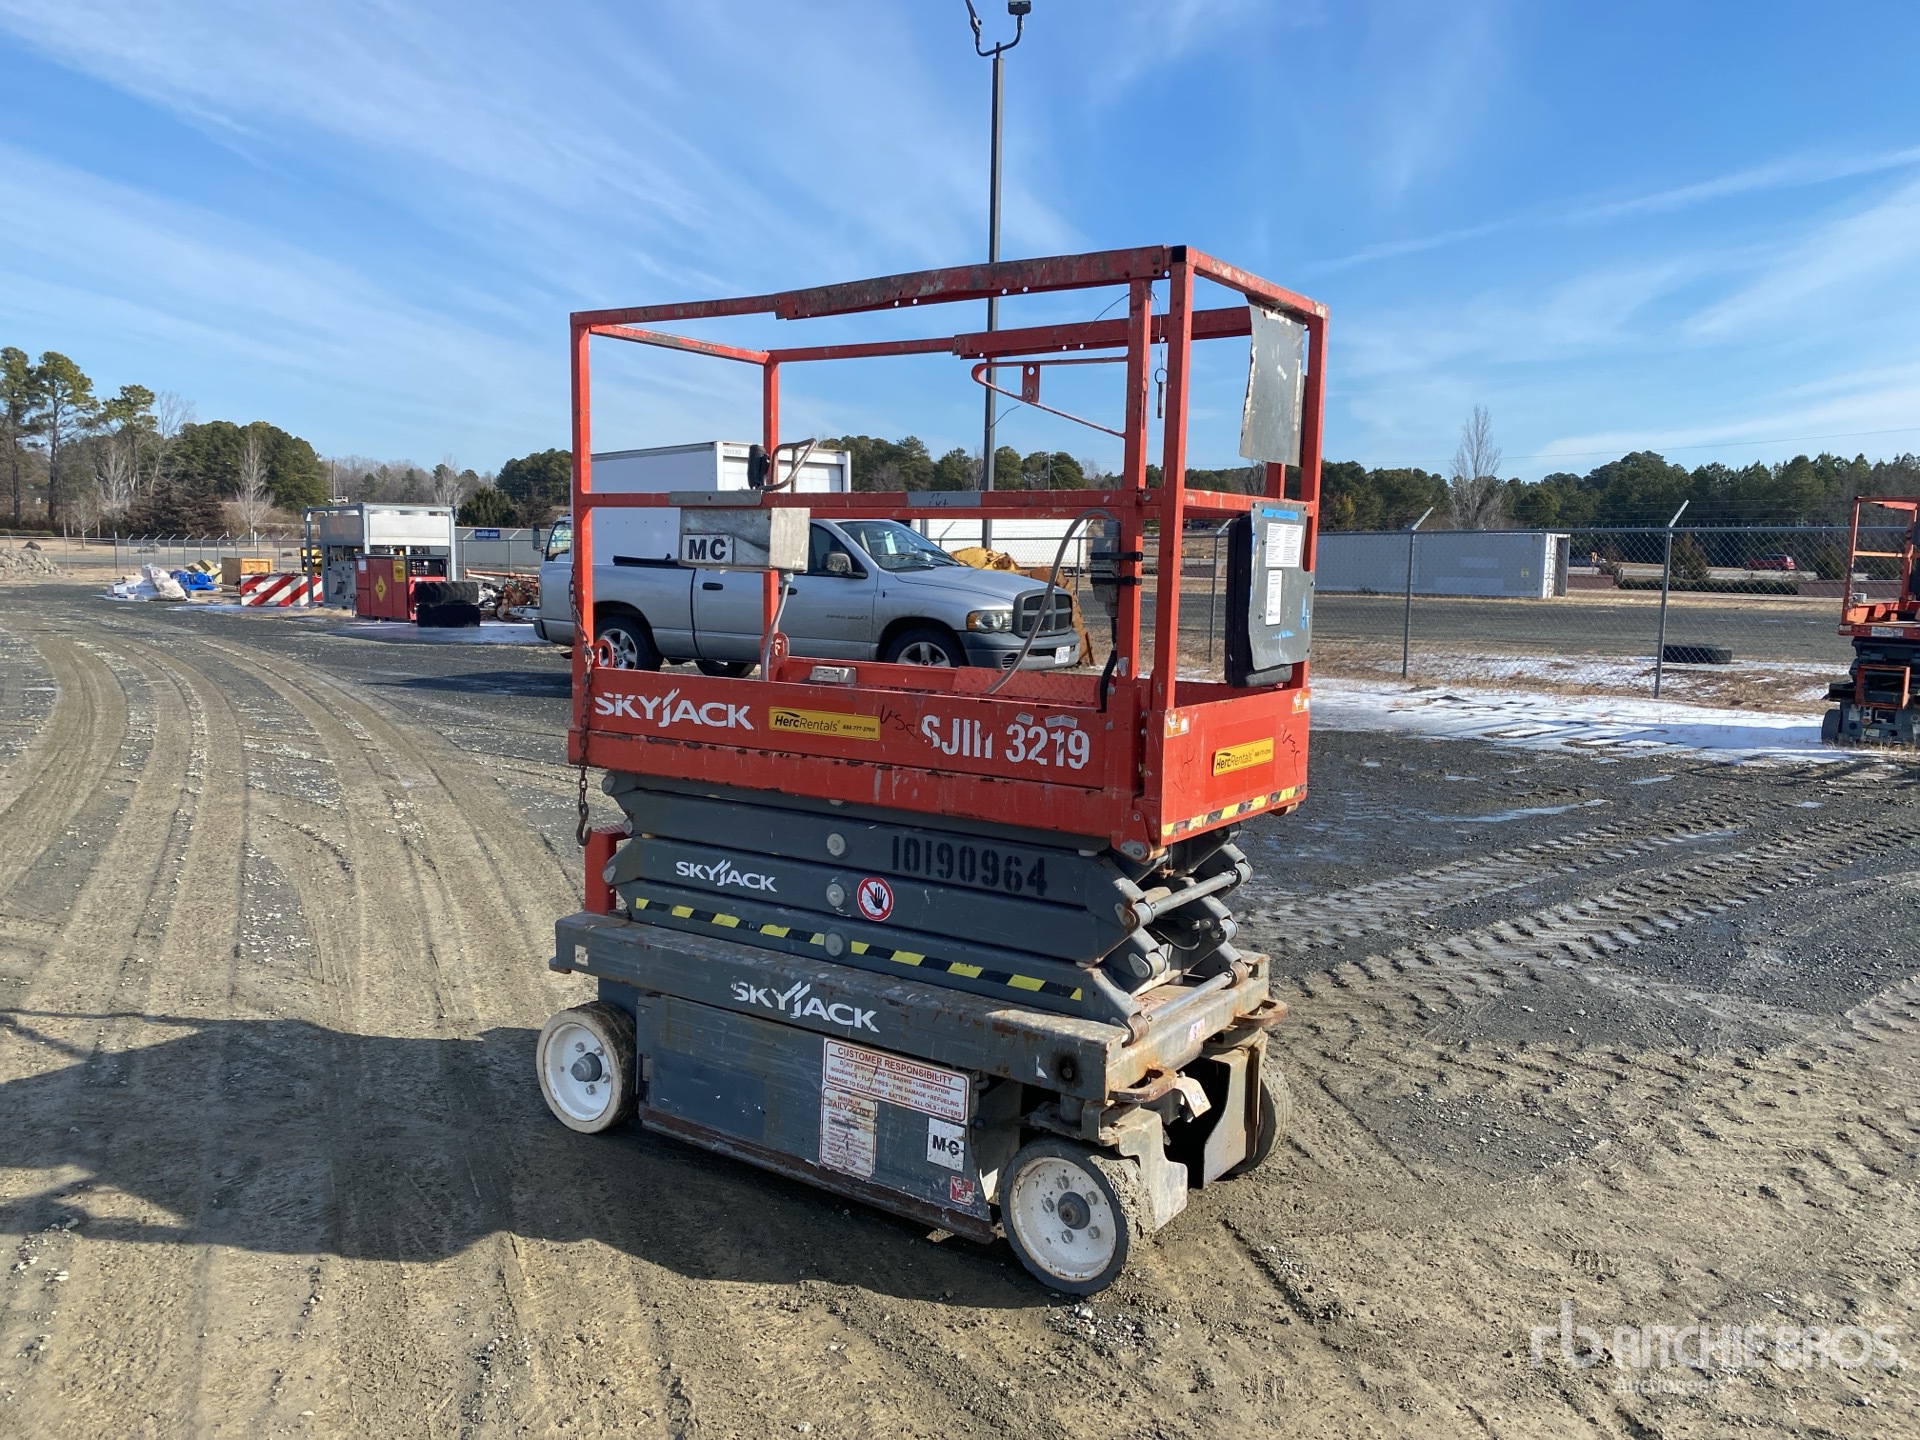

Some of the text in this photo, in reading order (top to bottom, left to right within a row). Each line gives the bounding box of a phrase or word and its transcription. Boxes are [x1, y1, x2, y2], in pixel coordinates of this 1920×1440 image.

[688, 538, 727, 560] MC
[594, 688, 754, 730] SKYJACK
[1005, 723, 1091, 770] 3219
[675, 859, 778, 893] SKYJACK
[892, 835, 1048, 897] 10190964
[730, 981, 880, 1034] SKYJACK
[838, 1047, 953, 1085] CUSTOMER RESPONSIBILITY
[827, 1074, 849, 1085] DAMAGE
[888, 1091, 911, 1103] BATTERY
[913, 1099, 924, 1108] ALL
[924, 1102, 937, 1110] OILS
[940, 1107, 962, 1118] FILTERS
[904, 1087, 927, 1098] DAMAGE
[930, 1094, 960, 1108] REFUELING
[915, 1081, 951, 1096] LUBRICATION
